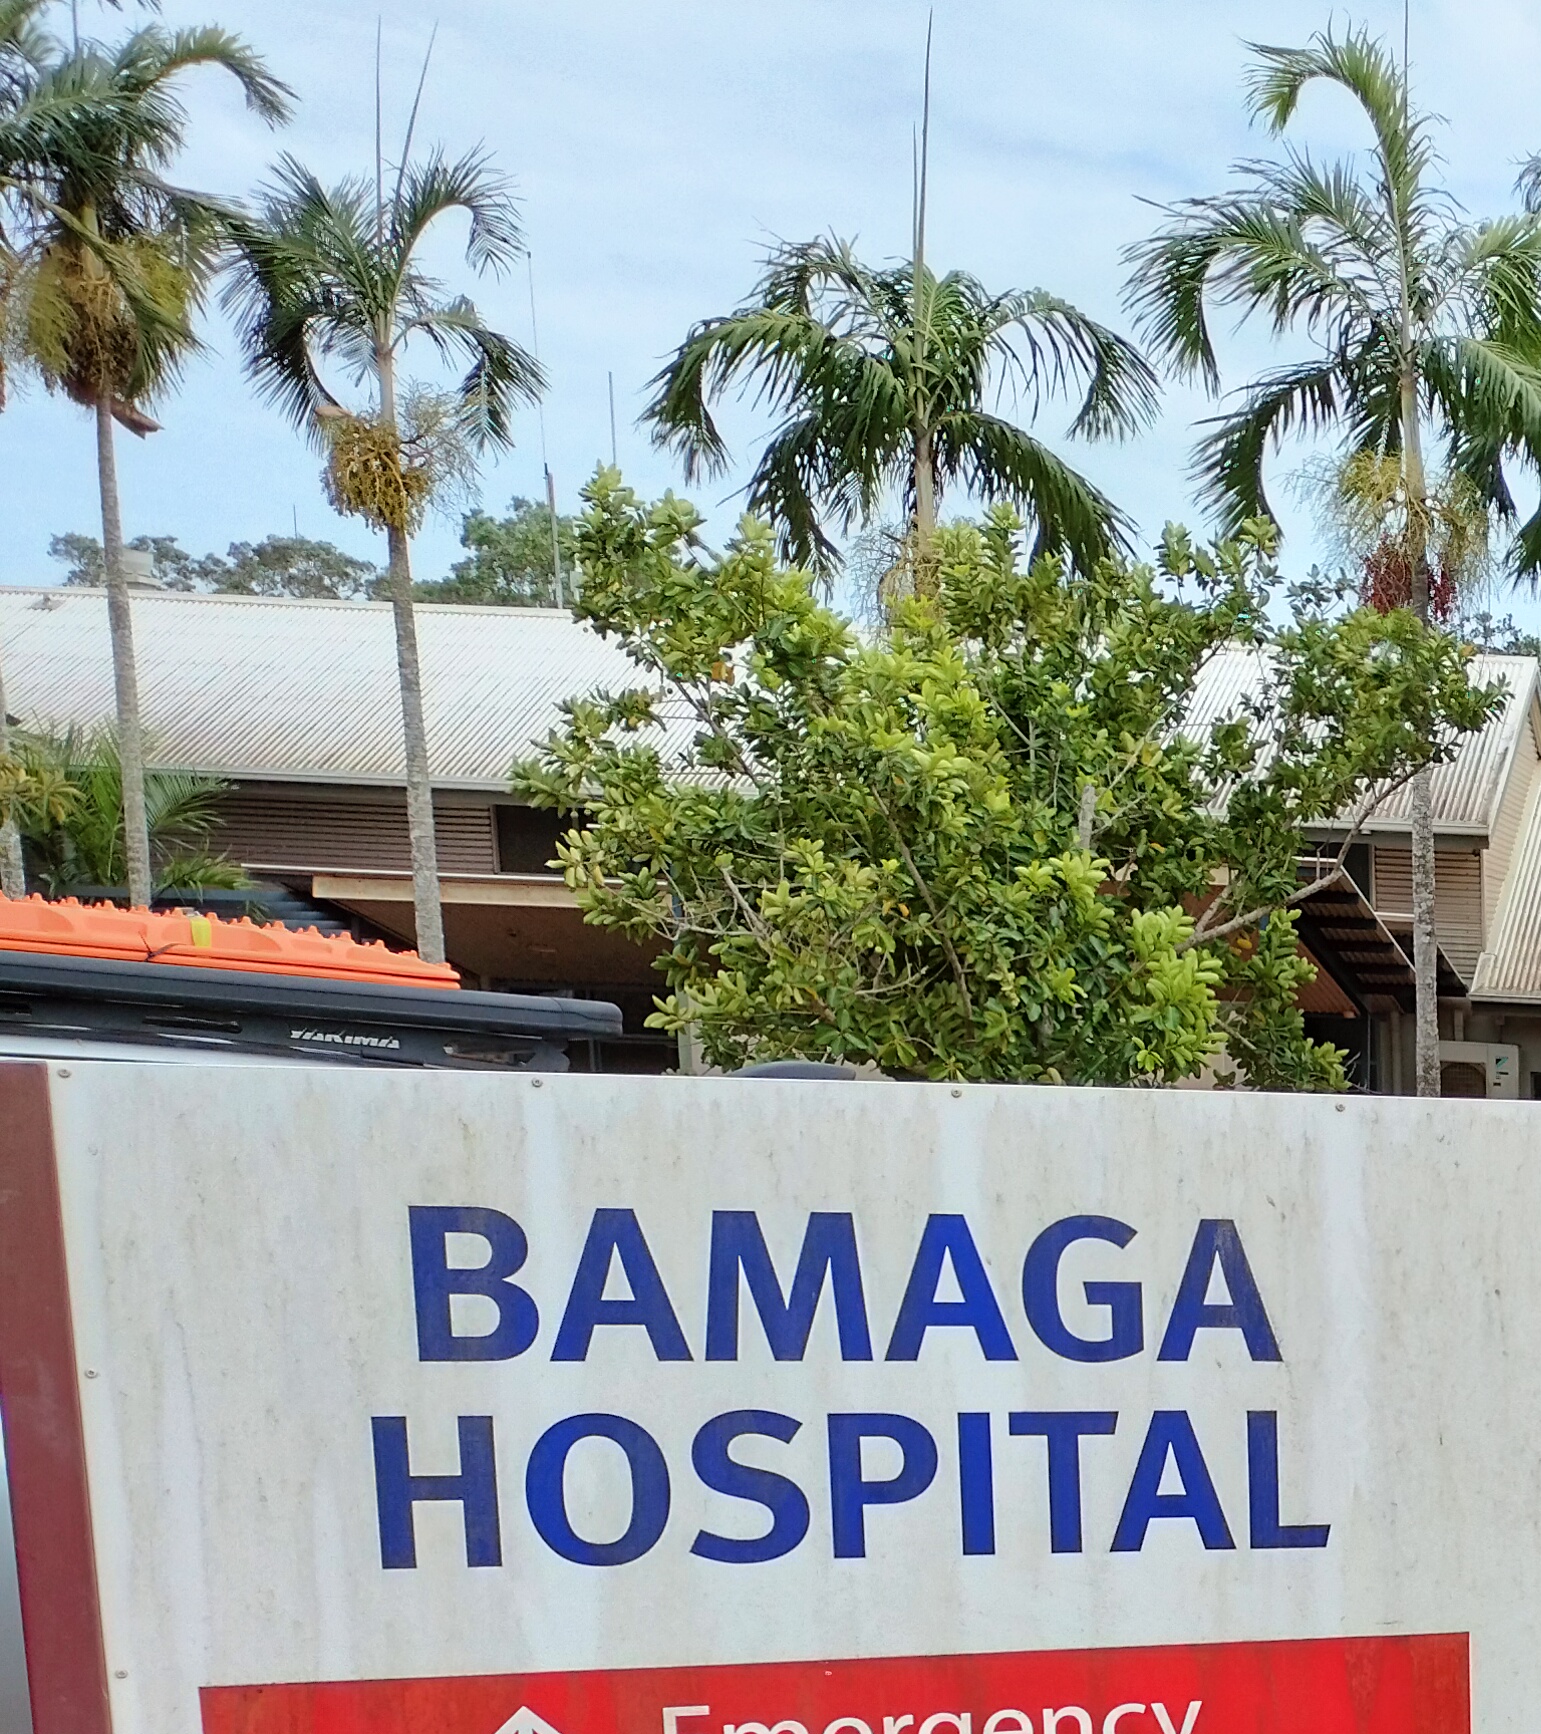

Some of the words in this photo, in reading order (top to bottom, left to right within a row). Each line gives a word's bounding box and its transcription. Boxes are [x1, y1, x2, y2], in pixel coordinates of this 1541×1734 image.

[290, 1027, 401, 1050] YAKIMA
[408, 1206, 1283, 1363] BAMAGA
[371, 1410, 1331, 1569] HOSPITAL
